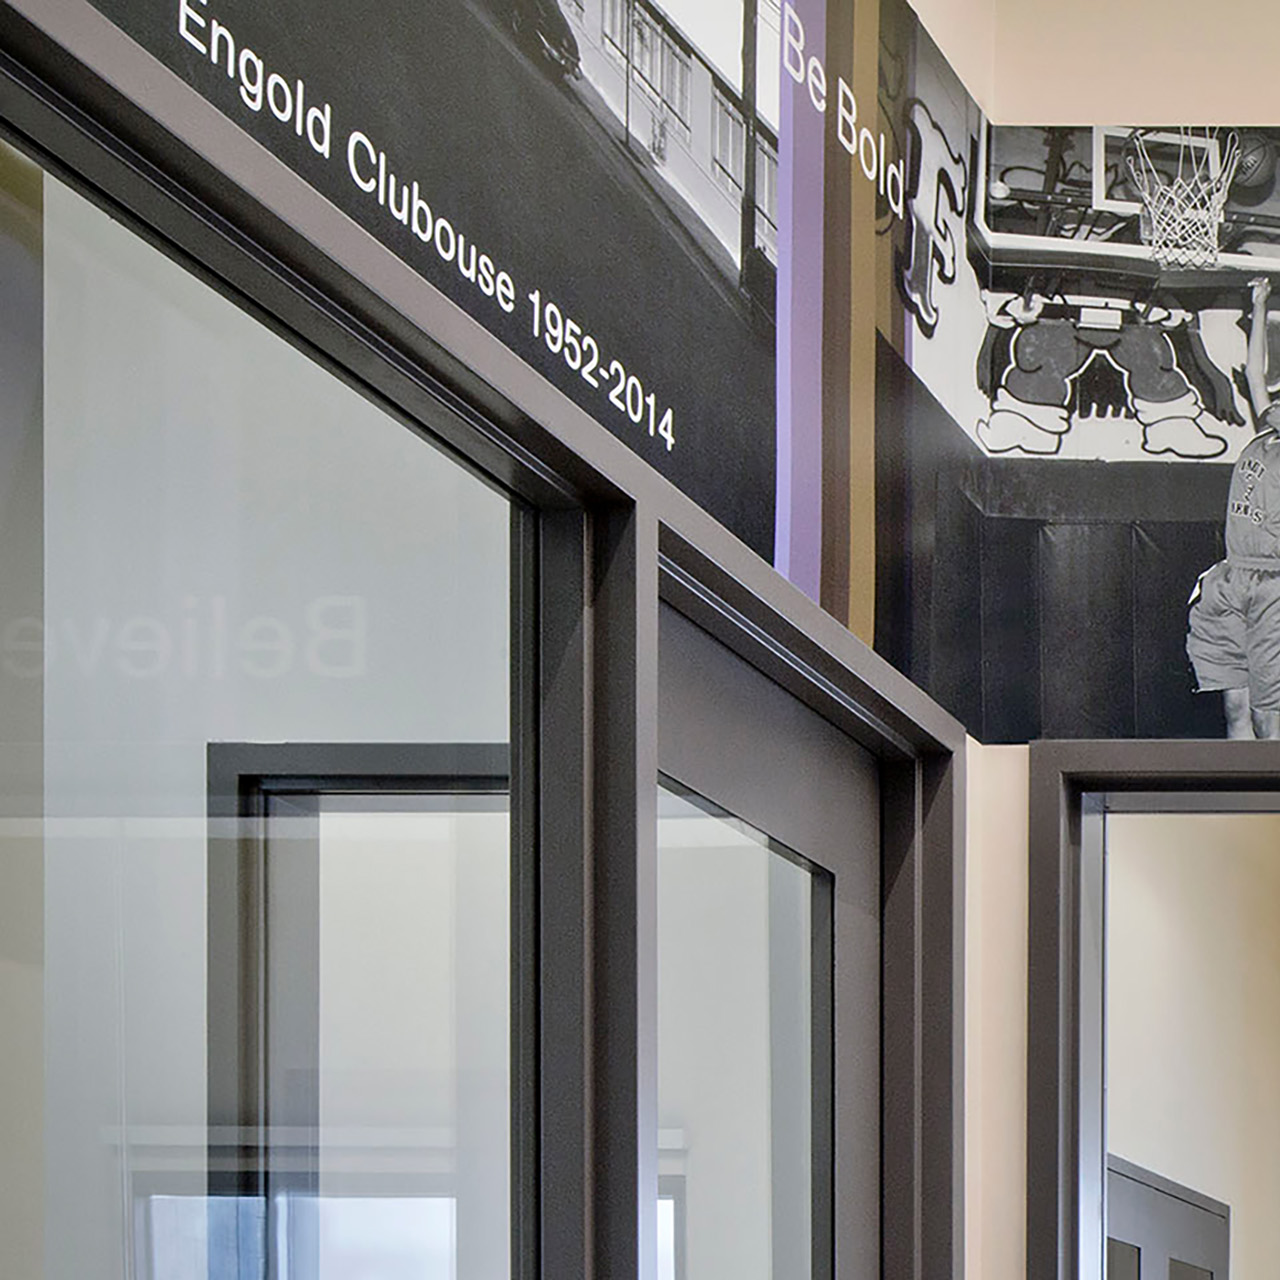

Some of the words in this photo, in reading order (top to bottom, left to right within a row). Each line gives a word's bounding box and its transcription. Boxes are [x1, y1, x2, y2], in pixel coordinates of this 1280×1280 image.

[179, 0, 331, 159] Engold
[347, 131, 515, 313] Clubouse
[528, 289, 676, 451] 1952-2014
[783, 1, 827, 113] Be
[838, 76, 904, 220] Bold
